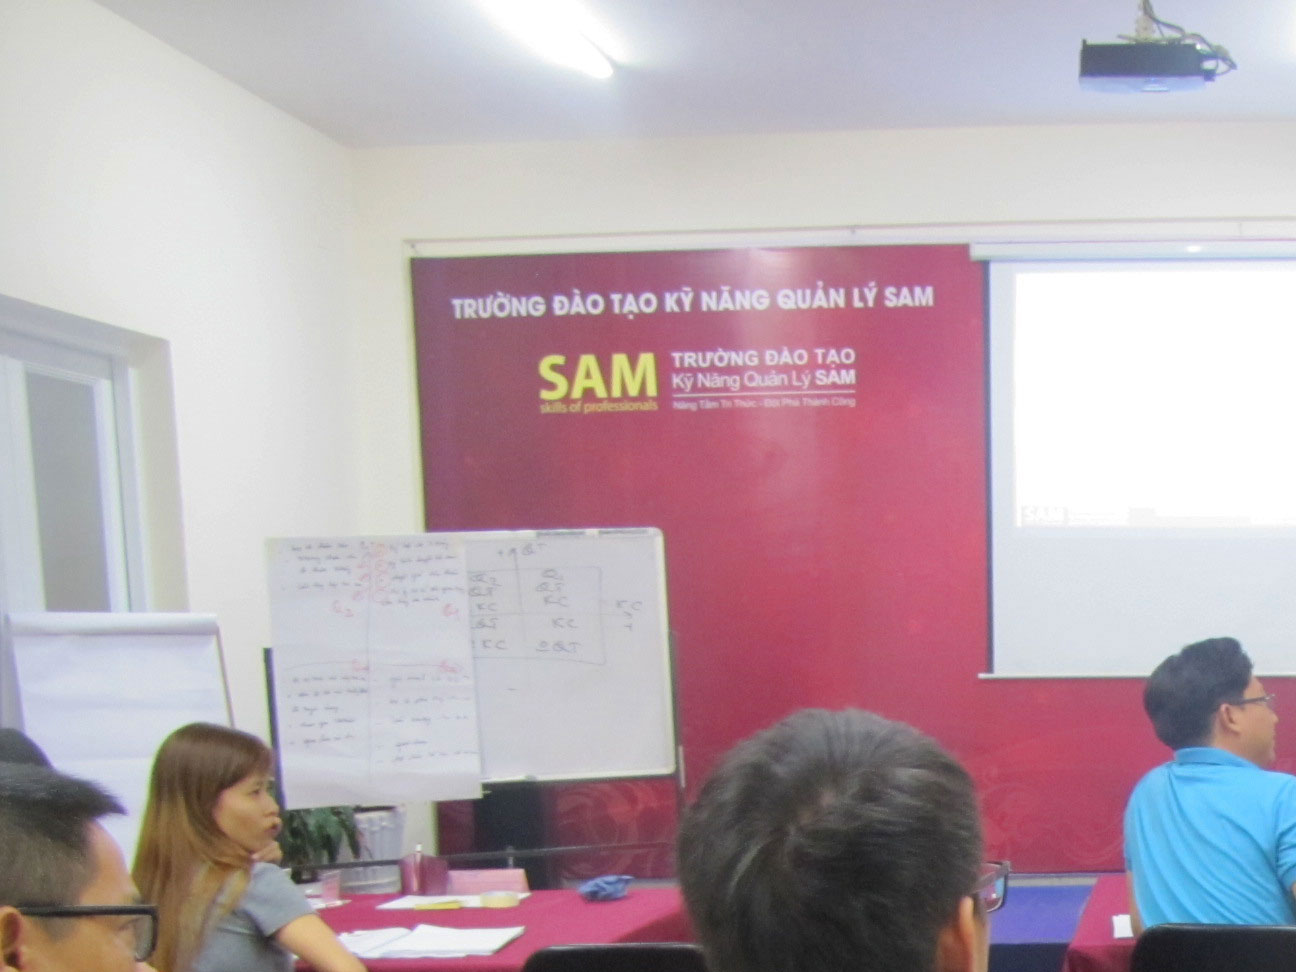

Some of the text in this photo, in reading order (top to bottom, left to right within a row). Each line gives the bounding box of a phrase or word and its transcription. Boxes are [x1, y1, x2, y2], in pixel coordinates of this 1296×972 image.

[451, 280, 935, 319] TRƯỜNG ĐÀO TẠO KỸ NĂNG QUẢN LÝ SAM
[671, 346, 856, 369] TRƯỜNG ĐÀO TẠO
[538, 352, 659, 401] SAM
[672, 369, 857, 393] Kỹ Năng Quản Lý SAM
[540, 399, 659, 415] skills of professionals
